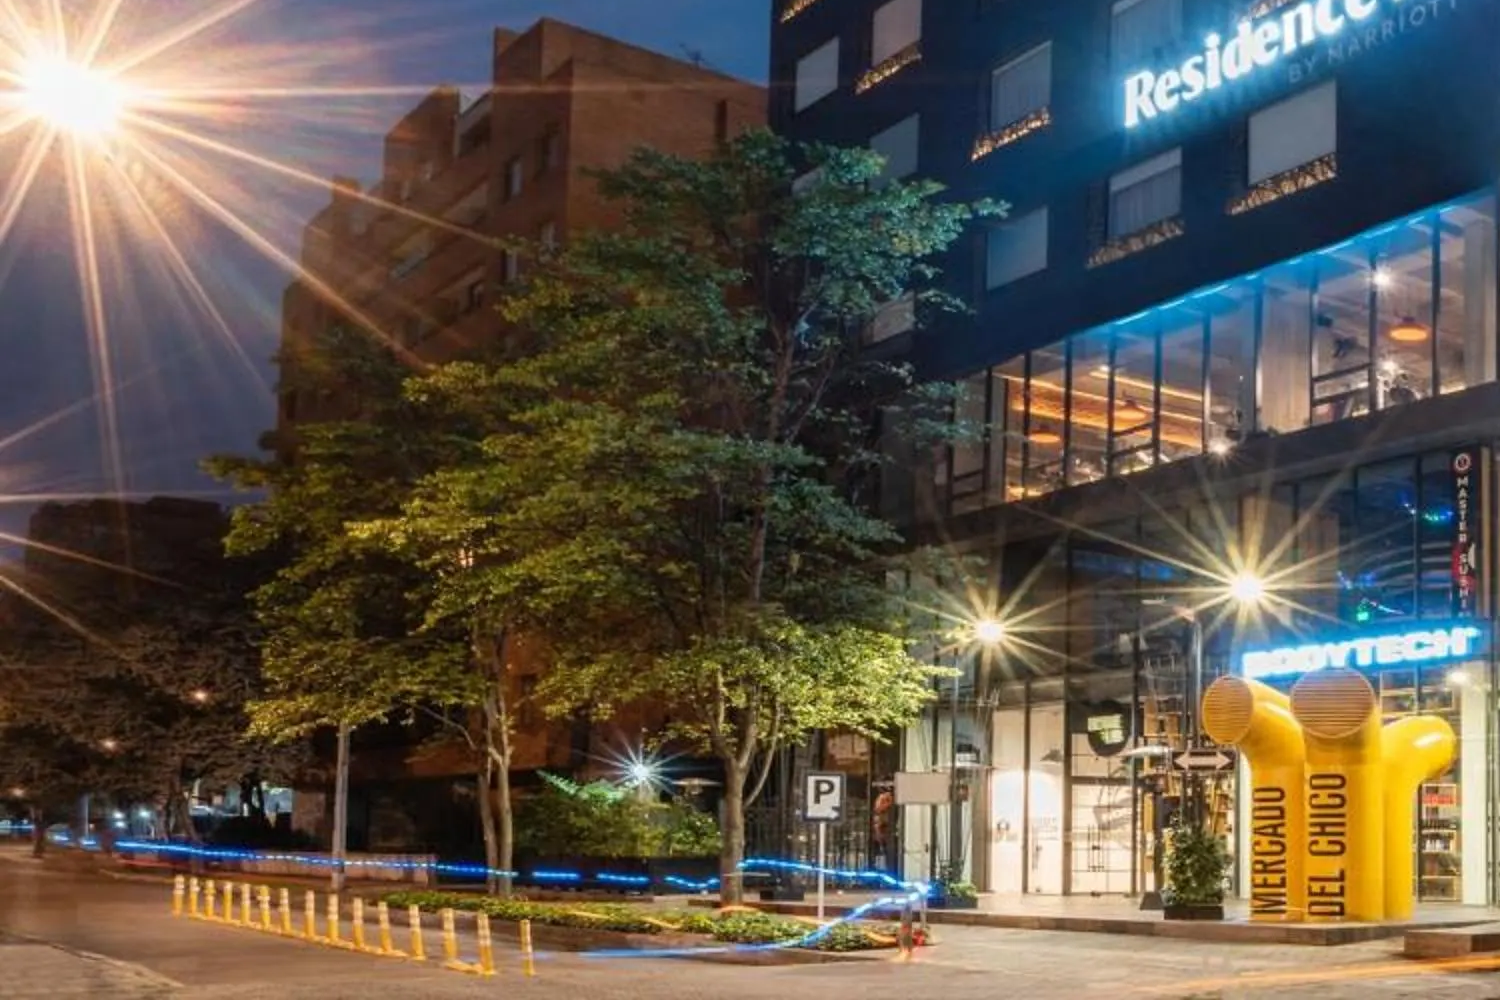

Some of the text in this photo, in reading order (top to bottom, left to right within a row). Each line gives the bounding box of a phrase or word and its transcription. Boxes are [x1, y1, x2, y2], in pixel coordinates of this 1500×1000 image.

[1289, 47, 1317, 83] BY
[1456, 477, 1469, 543] MASTER
[1458, 553, 1469, 609] SUSHI
[813, 779, 834, 804] P
[1251, 786, 1286, 915] MERCADO
[1308, 773, 1347, 916] DEL CHICO
